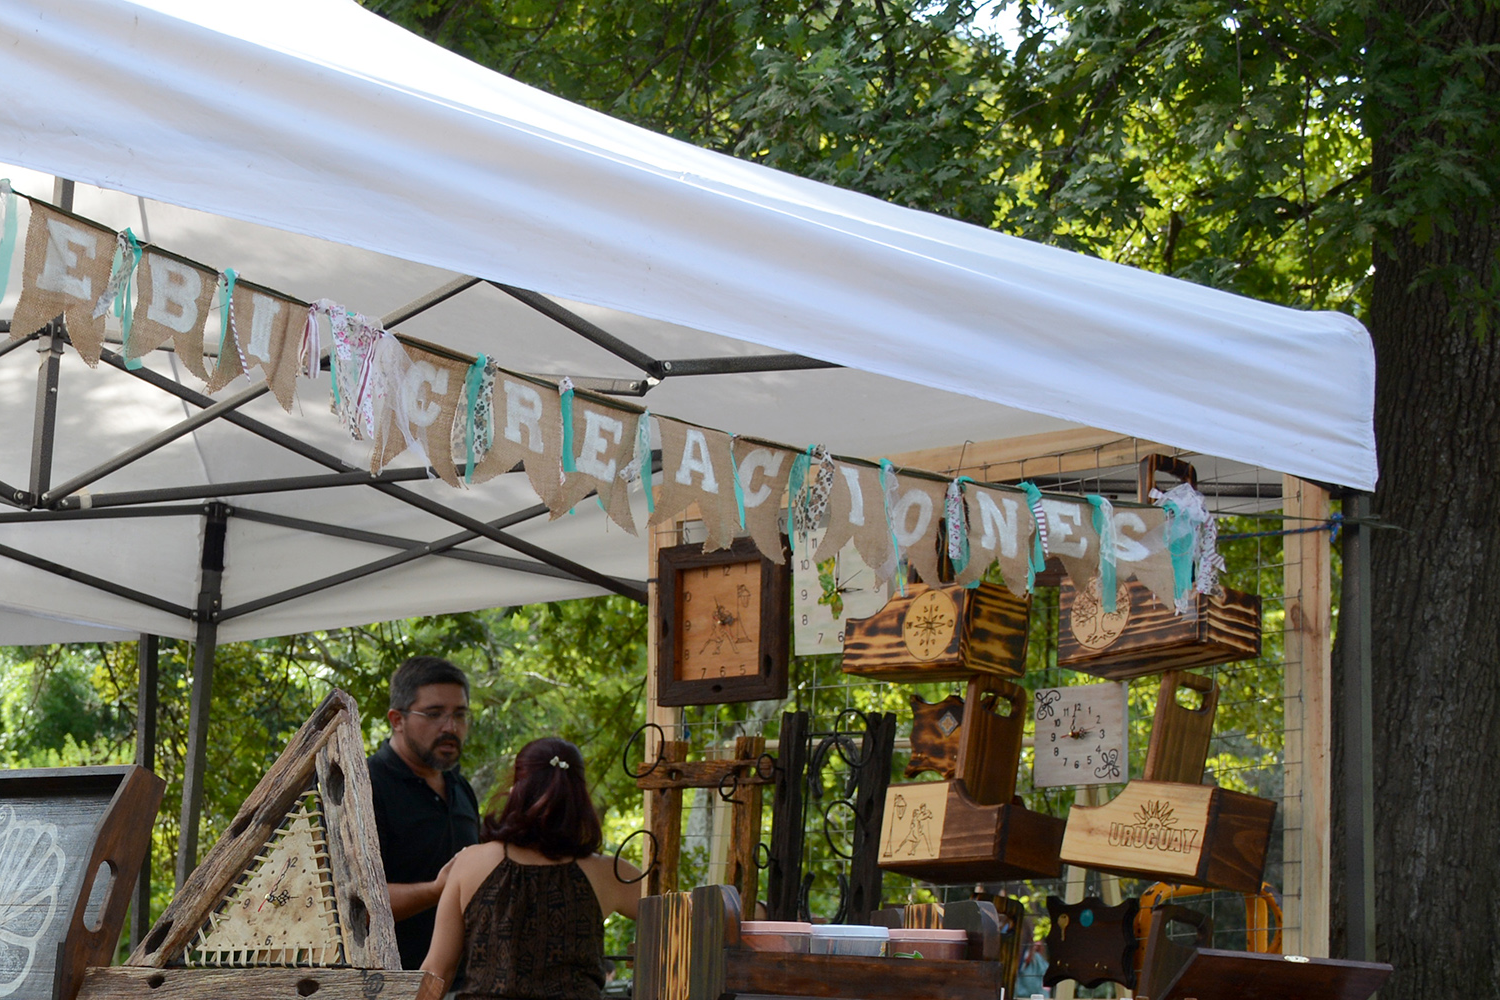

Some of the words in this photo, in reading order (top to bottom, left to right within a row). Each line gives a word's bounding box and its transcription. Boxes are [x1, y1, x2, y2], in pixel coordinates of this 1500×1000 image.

[800, 559, 810, 571] 10
[800, 589, 808, 601] 9
[801, 614, 809, 626] 8
[817, 632, 824, 644] 7
[837, 631, 844, 643] 6
[720, 666, 725, 677] 6
[740, 665, 746, 676] 5
[1063, 707, 1070, 717] 11
[1054, 718, 1061, 728] 10
[1096, 715, 1100, 724] 2
[1050, 732, 1057, 742] 9
[1100, 729, 1105, 739] 3
[1053, 746, 1060, 757] 8
[1095, 744, 1102, 755] 4
[1062, 757, 1068, 767] 7
[1073, 760, 1080, 769] 6
[1087, 756, 1092, 765] 5
[1108, 822, 1199, 855] URUGUAY
[243, 899, 250, 909] 9
[306, 897, 313, 908] 3
[265, 935, 272, 945] 6
